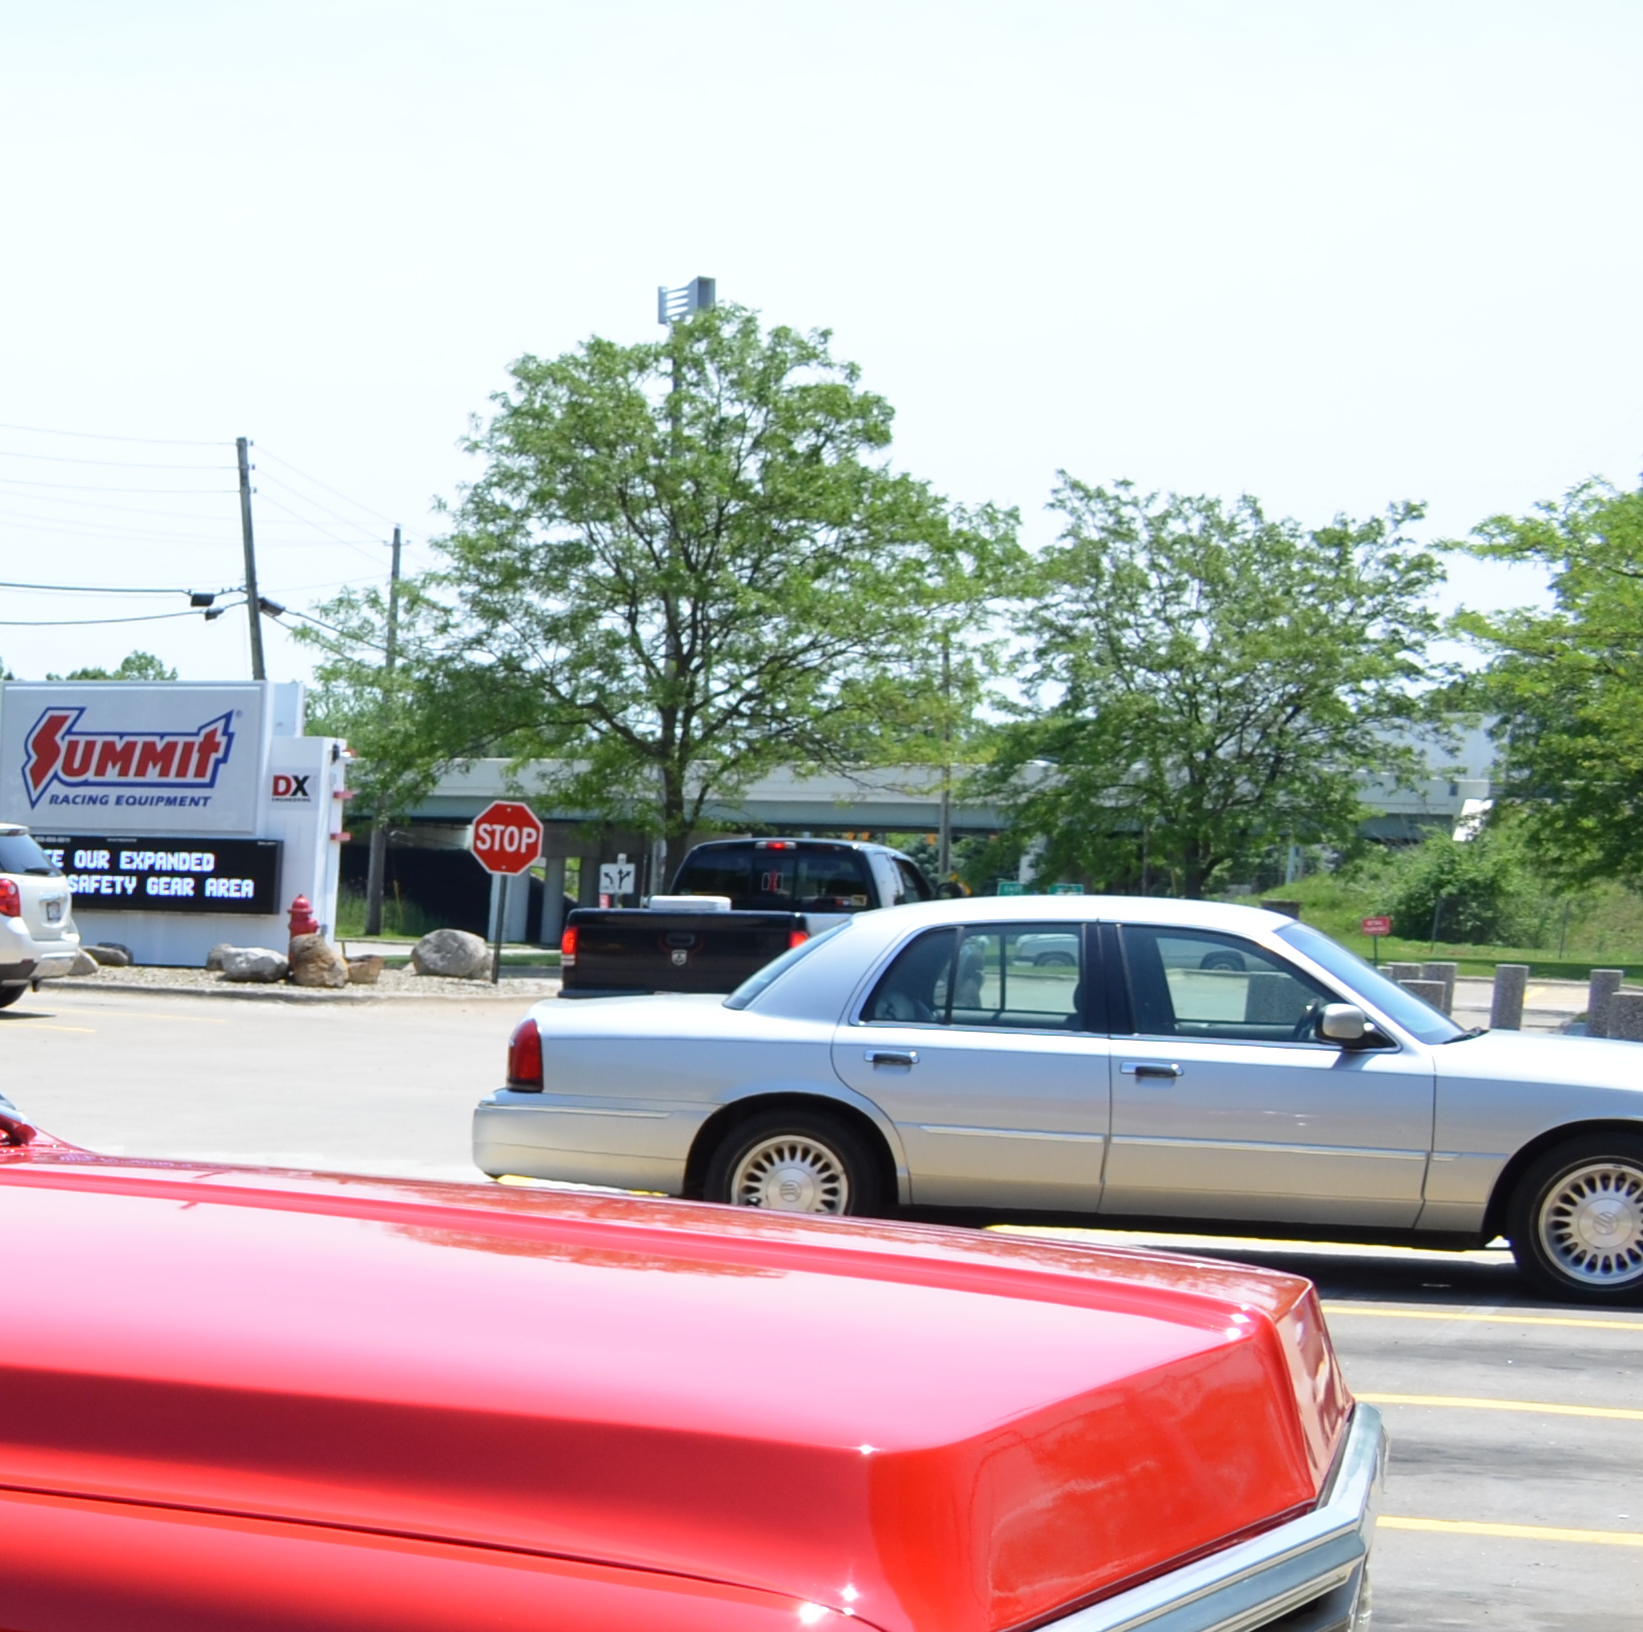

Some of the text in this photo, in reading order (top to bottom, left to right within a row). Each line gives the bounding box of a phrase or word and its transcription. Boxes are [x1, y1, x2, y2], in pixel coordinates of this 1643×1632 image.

[272, 775, 310, 797] DX
[49, 794, 212, 808] RACING EQUIPMENT
[476, 823, 537, 854] STOP
[73, 850, 111, 870] OUR
[119, 850, 216, 873] EXPANDED
[67, 874, 255, 899] SAFETY GEAR AREA
